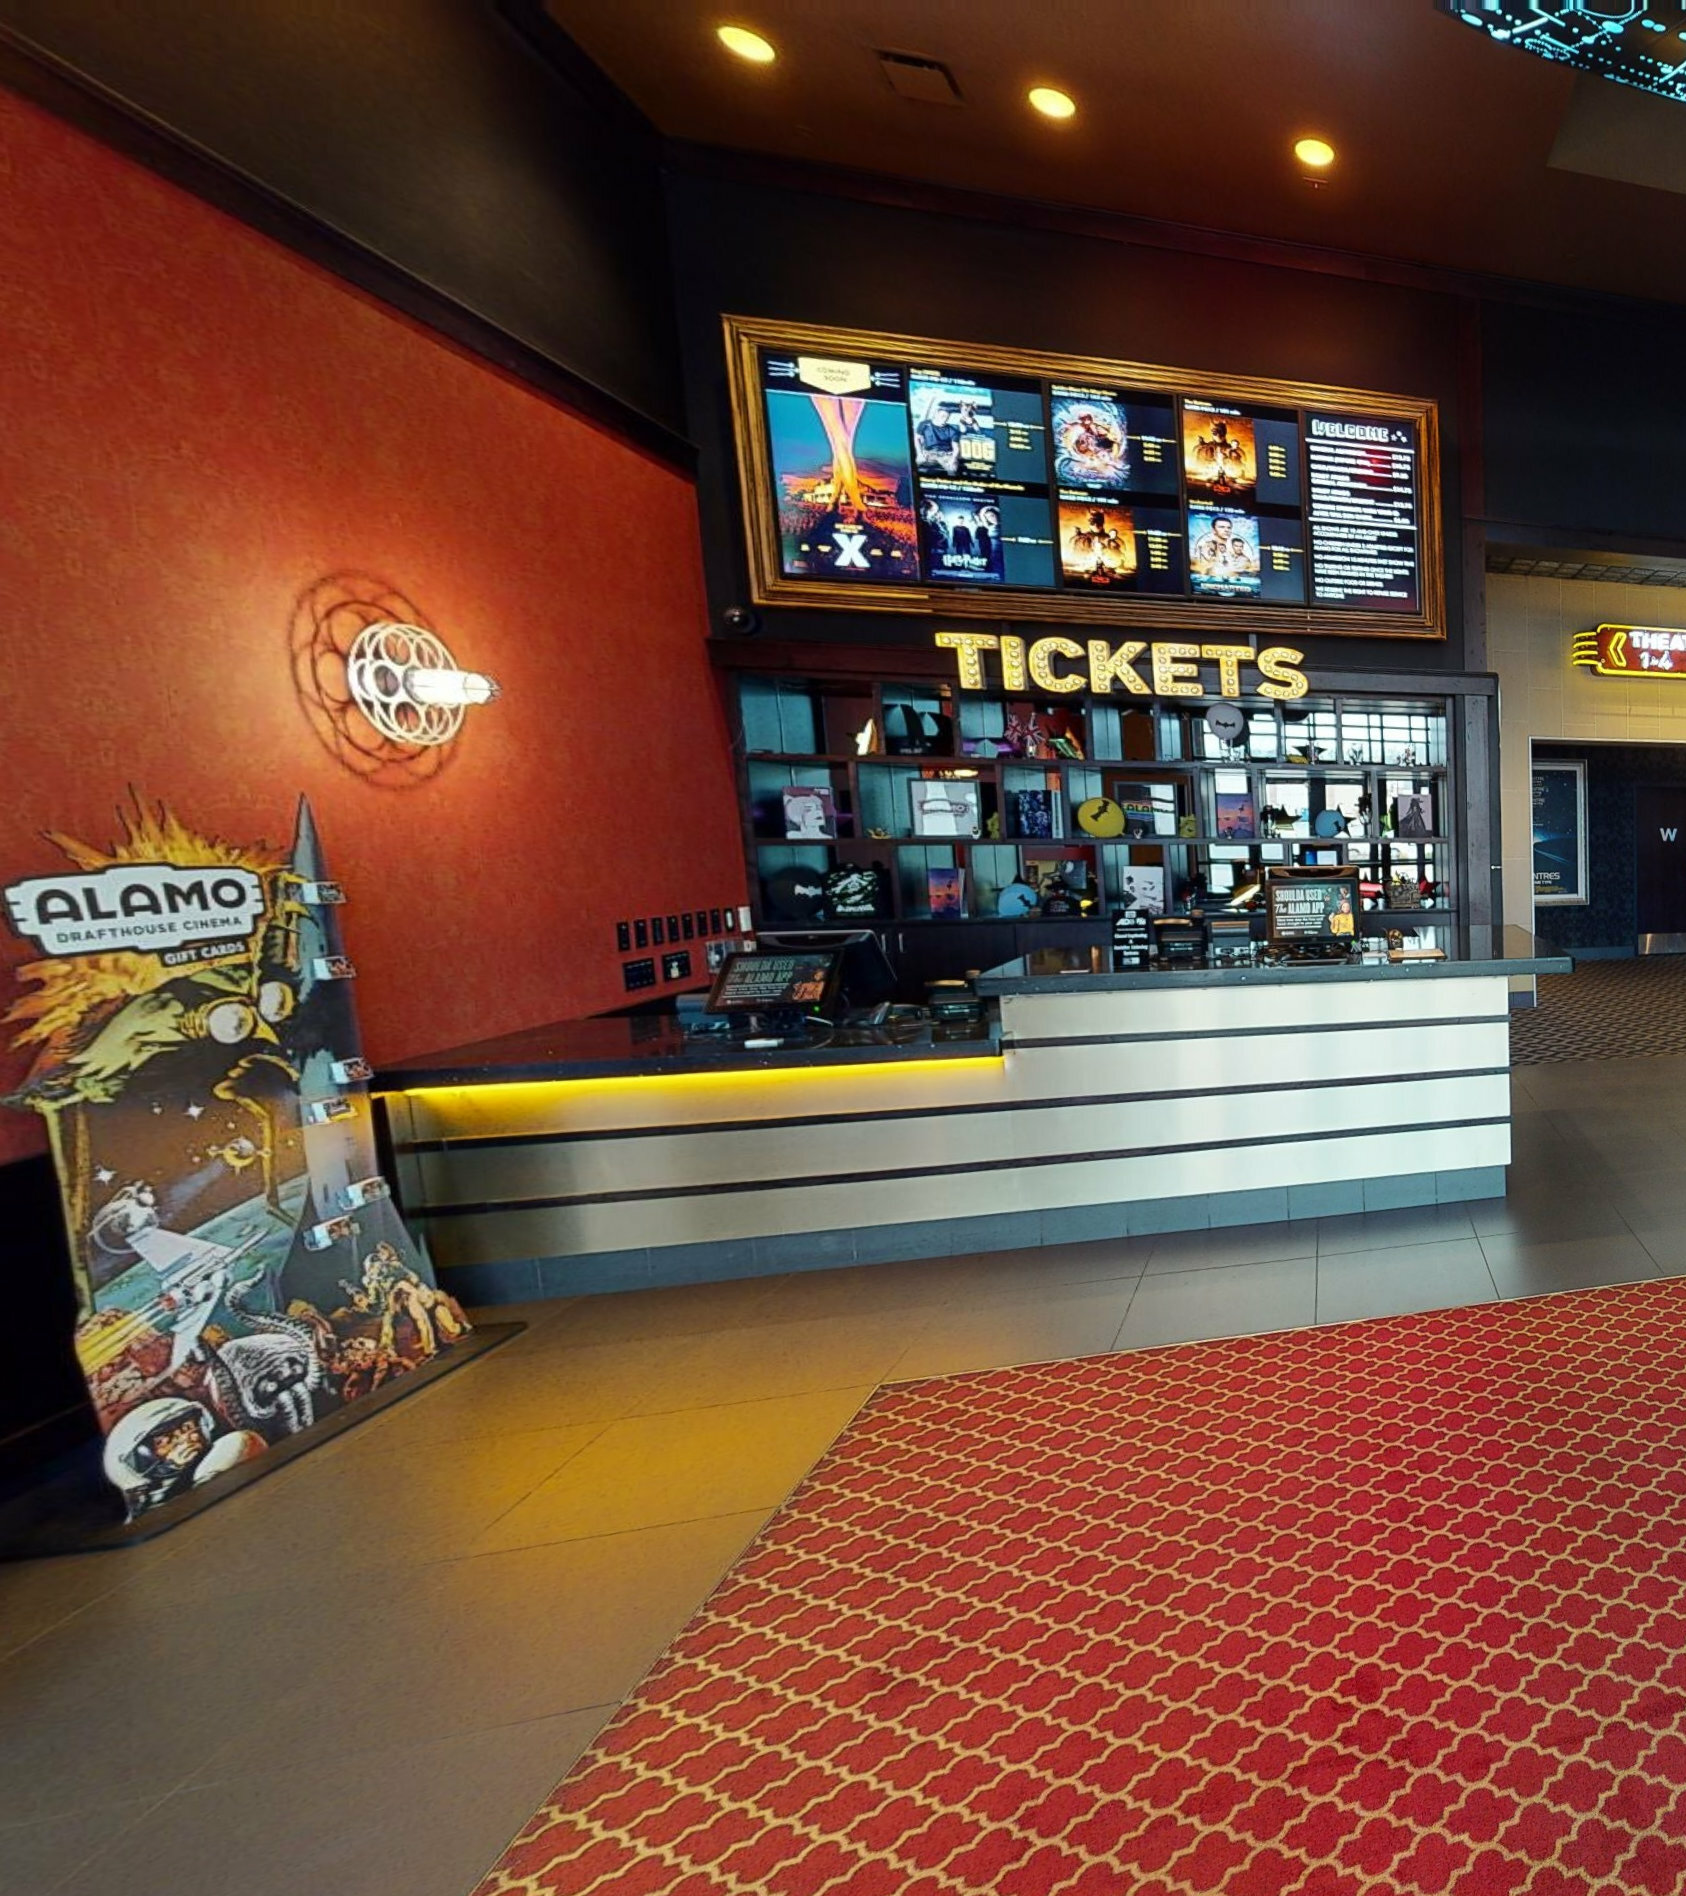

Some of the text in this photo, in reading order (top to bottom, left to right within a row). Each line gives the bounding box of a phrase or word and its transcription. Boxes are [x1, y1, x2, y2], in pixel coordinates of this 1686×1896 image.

[1312, 419, 1389, 442] WELCOME
[960, 439, 996, 462] DOG
[832, 533, 870, 568] X
[935, 632, 1309, 700] TICKETS
[1640, 651, 1674, 670] 1-4
[1660, 828, 1677, 841] W
[36, 877, 247, 925] ALAMO
[1275, 889, 1322, 901] SHOULDA USED
[1287, 902, 1311, 914] ALAMO
[1312, 901, 1324, 913] APP
[56, 916, 243, 944] DRAFTHOUSE CINEMA
[164, 940, 245, 965] GIFT CARDS
